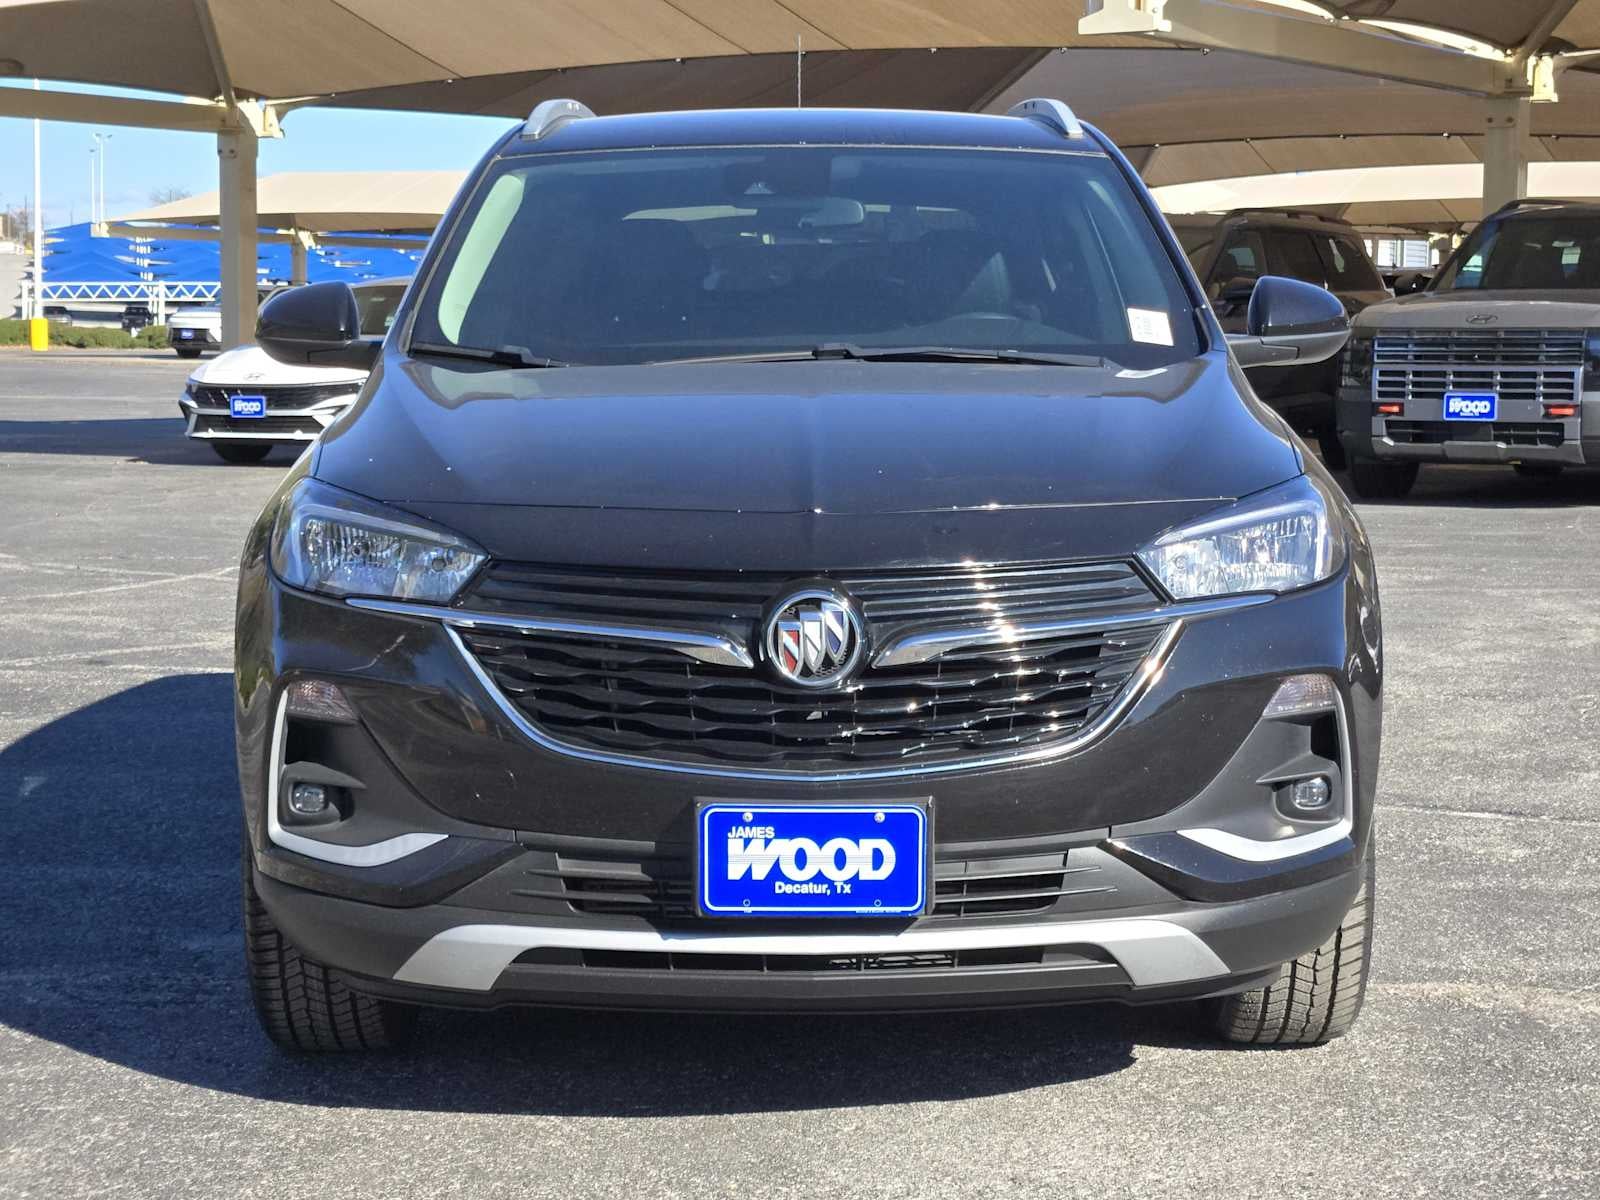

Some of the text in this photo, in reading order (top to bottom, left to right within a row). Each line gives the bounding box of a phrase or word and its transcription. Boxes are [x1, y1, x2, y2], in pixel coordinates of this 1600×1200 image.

[1449, 399, 1490, 413] WOOD
[727, 826, 775, 838] JAMES
[727, 837, 896, 882] WOOD
[774, 881, 851, 895] Decatur, Tx
